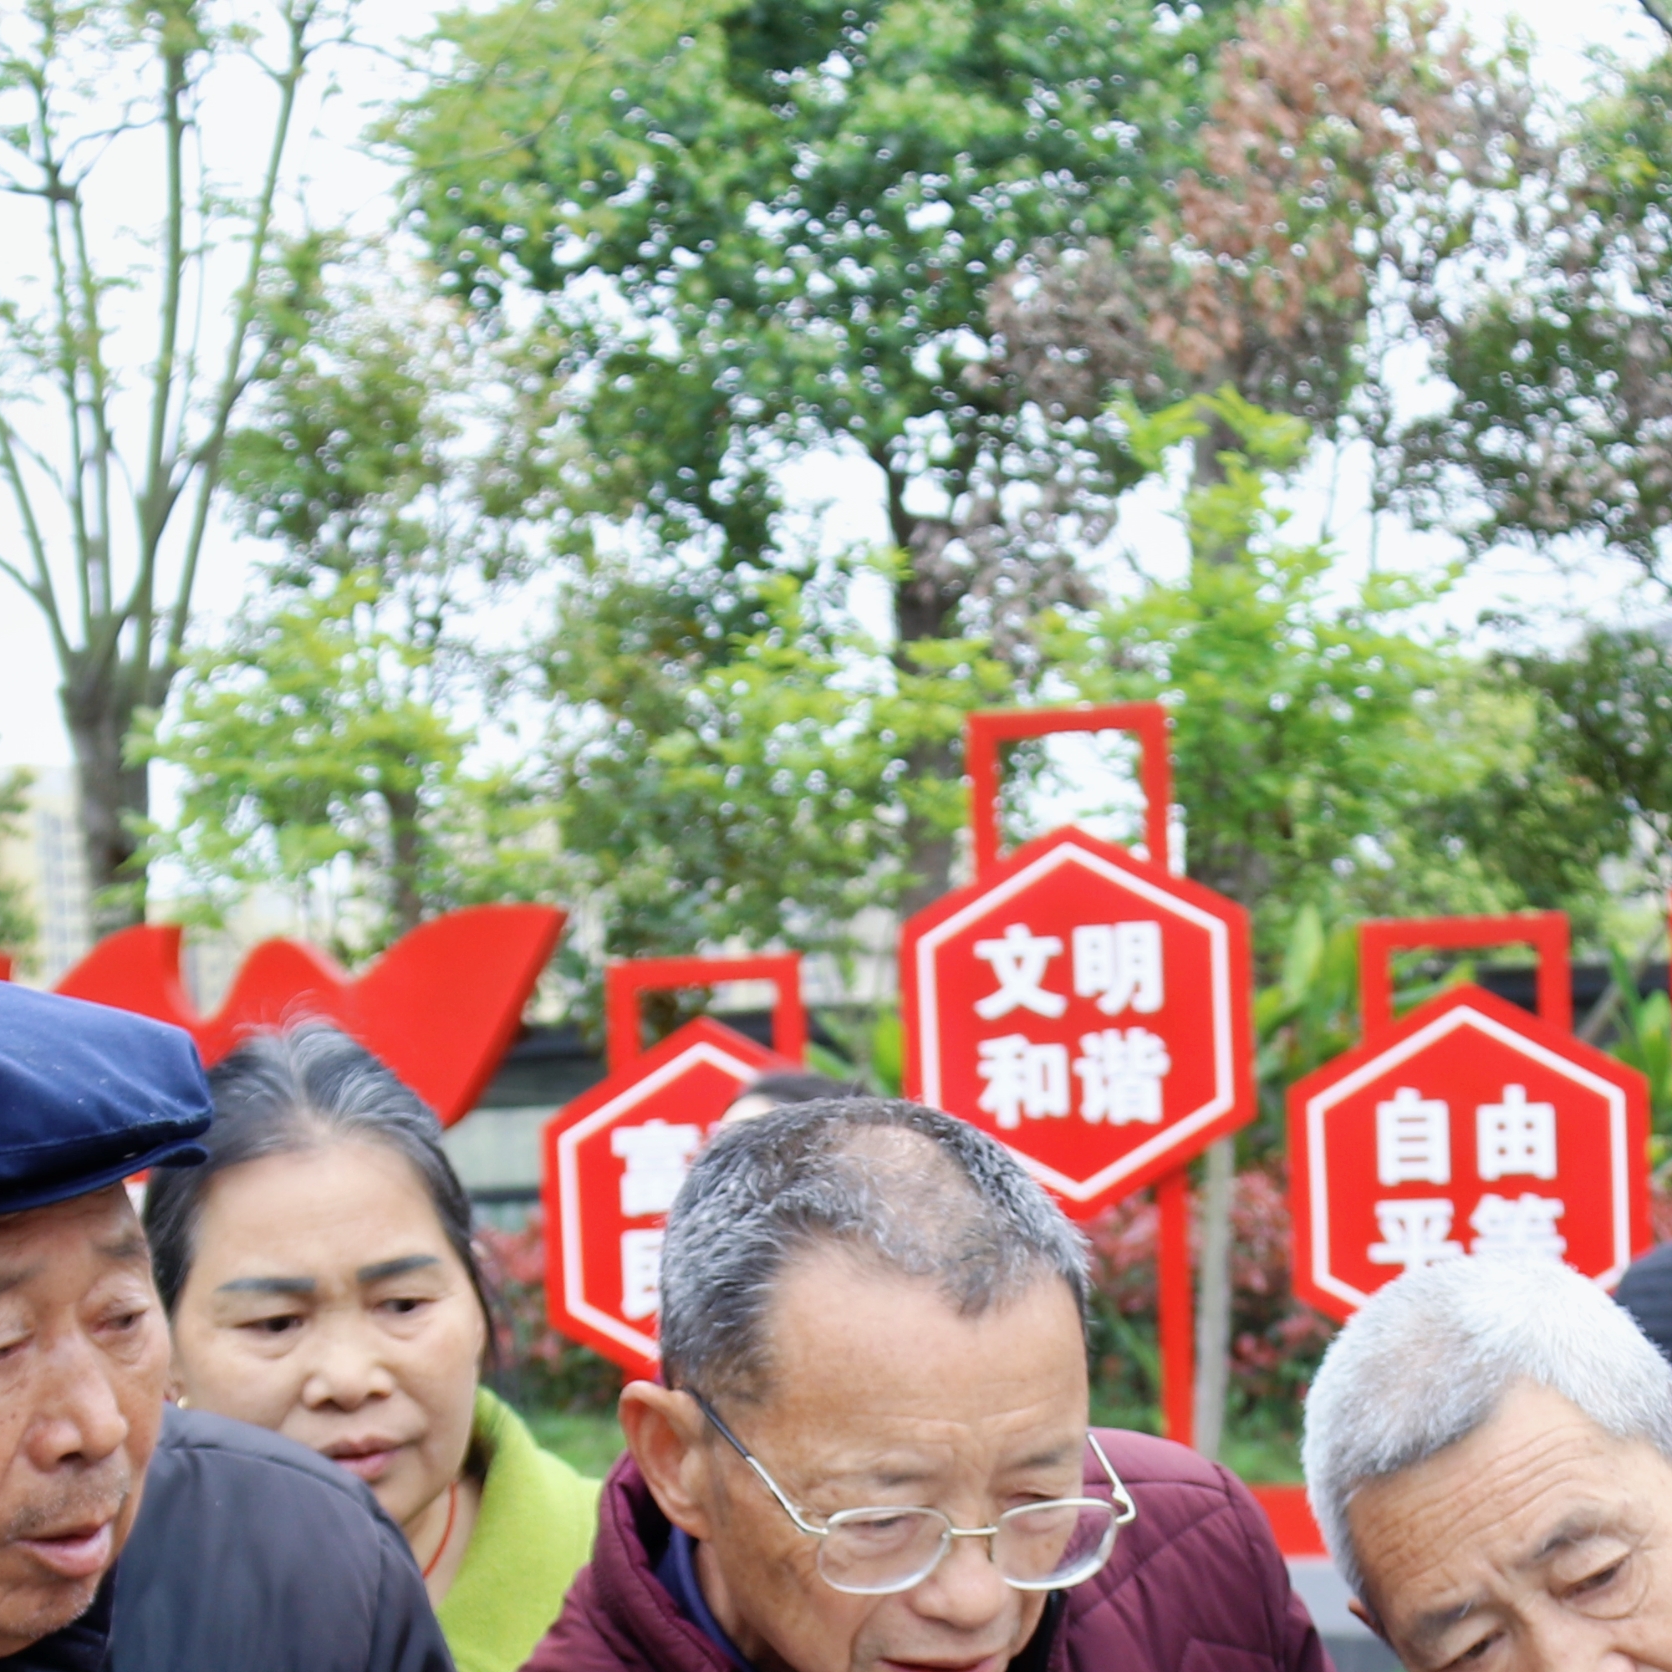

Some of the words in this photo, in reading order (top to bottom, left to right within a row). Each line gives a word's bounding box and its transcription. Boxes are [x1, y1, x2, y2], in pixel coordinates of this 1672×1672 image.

[973, 920, 1165, 1020] 文明
[977, 1027, 1172, 1129] 和谐
[611, 1117, 713, 1218] 富
[1374, 1084, 1558, 1187] 自由
